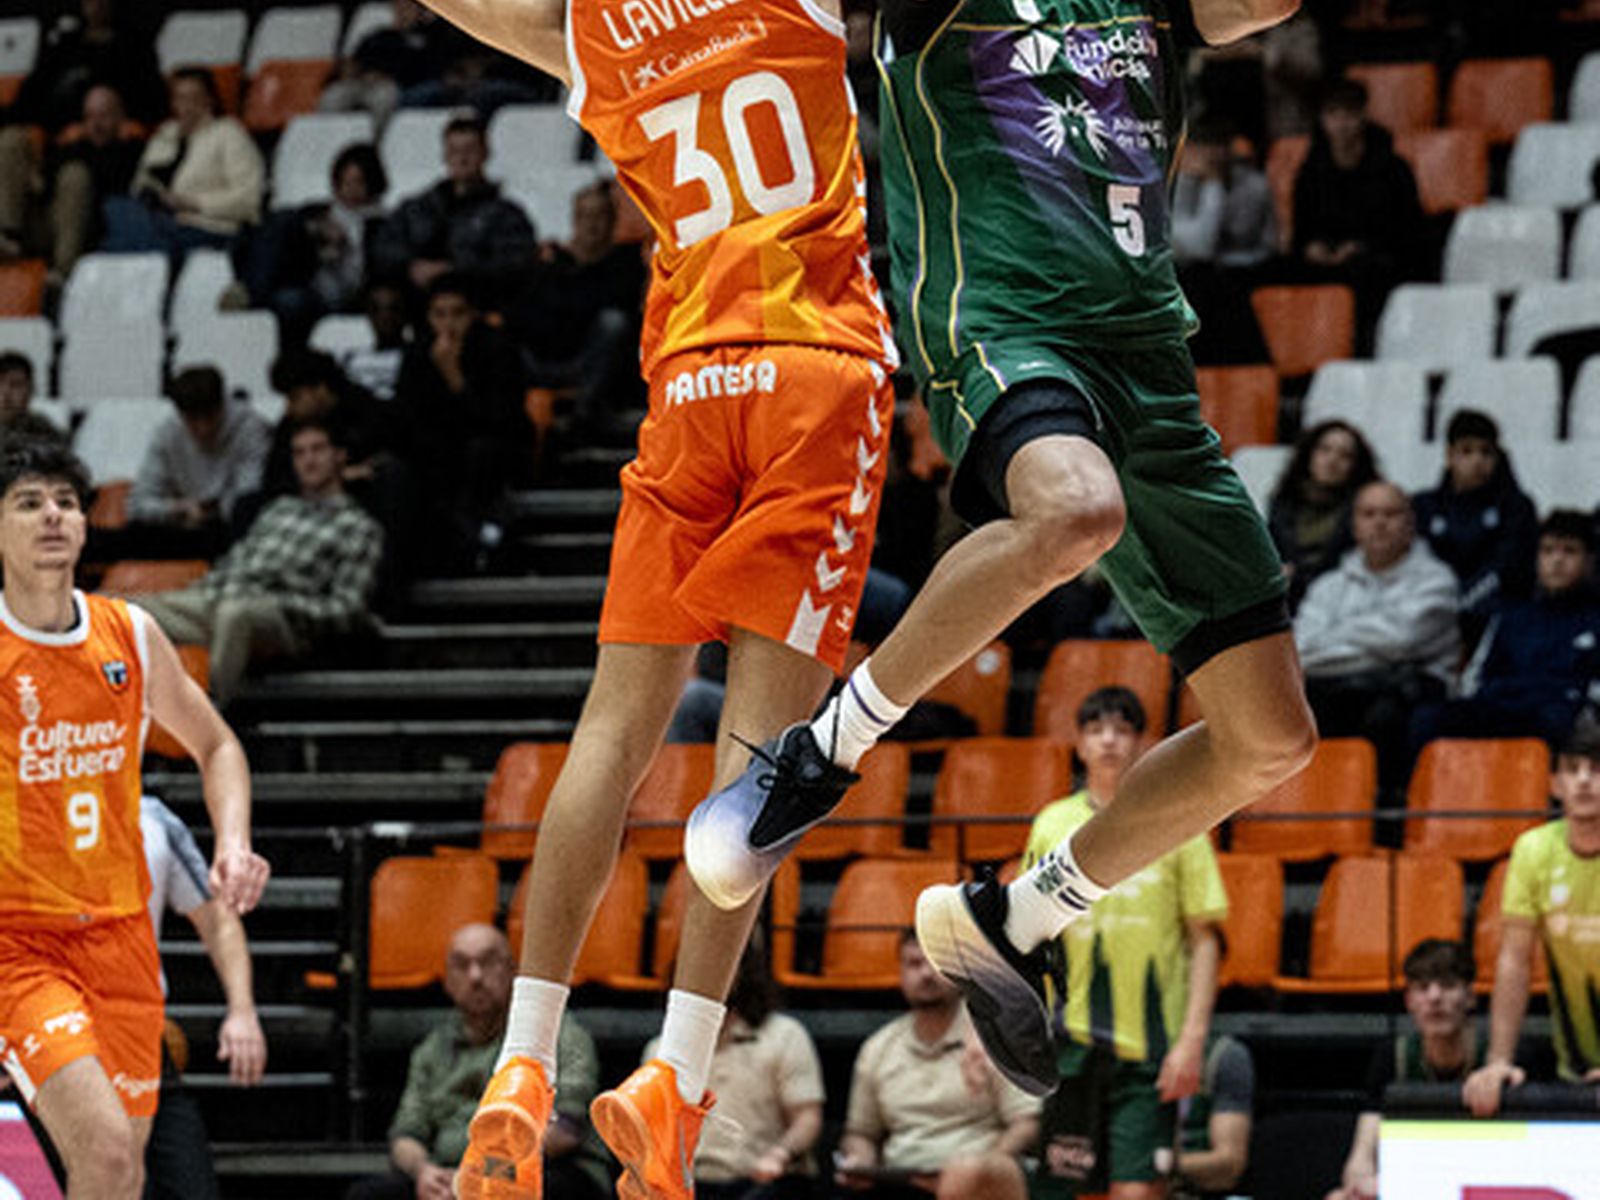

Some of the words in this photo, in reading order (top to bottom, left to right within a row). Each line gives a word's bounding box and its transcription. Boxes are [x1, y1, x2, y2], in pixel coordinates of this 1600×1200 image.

[639, 70, 815, 248] 30
[1106, 184, 1146, 258] 5
[67, 792, 100, 850] 9
